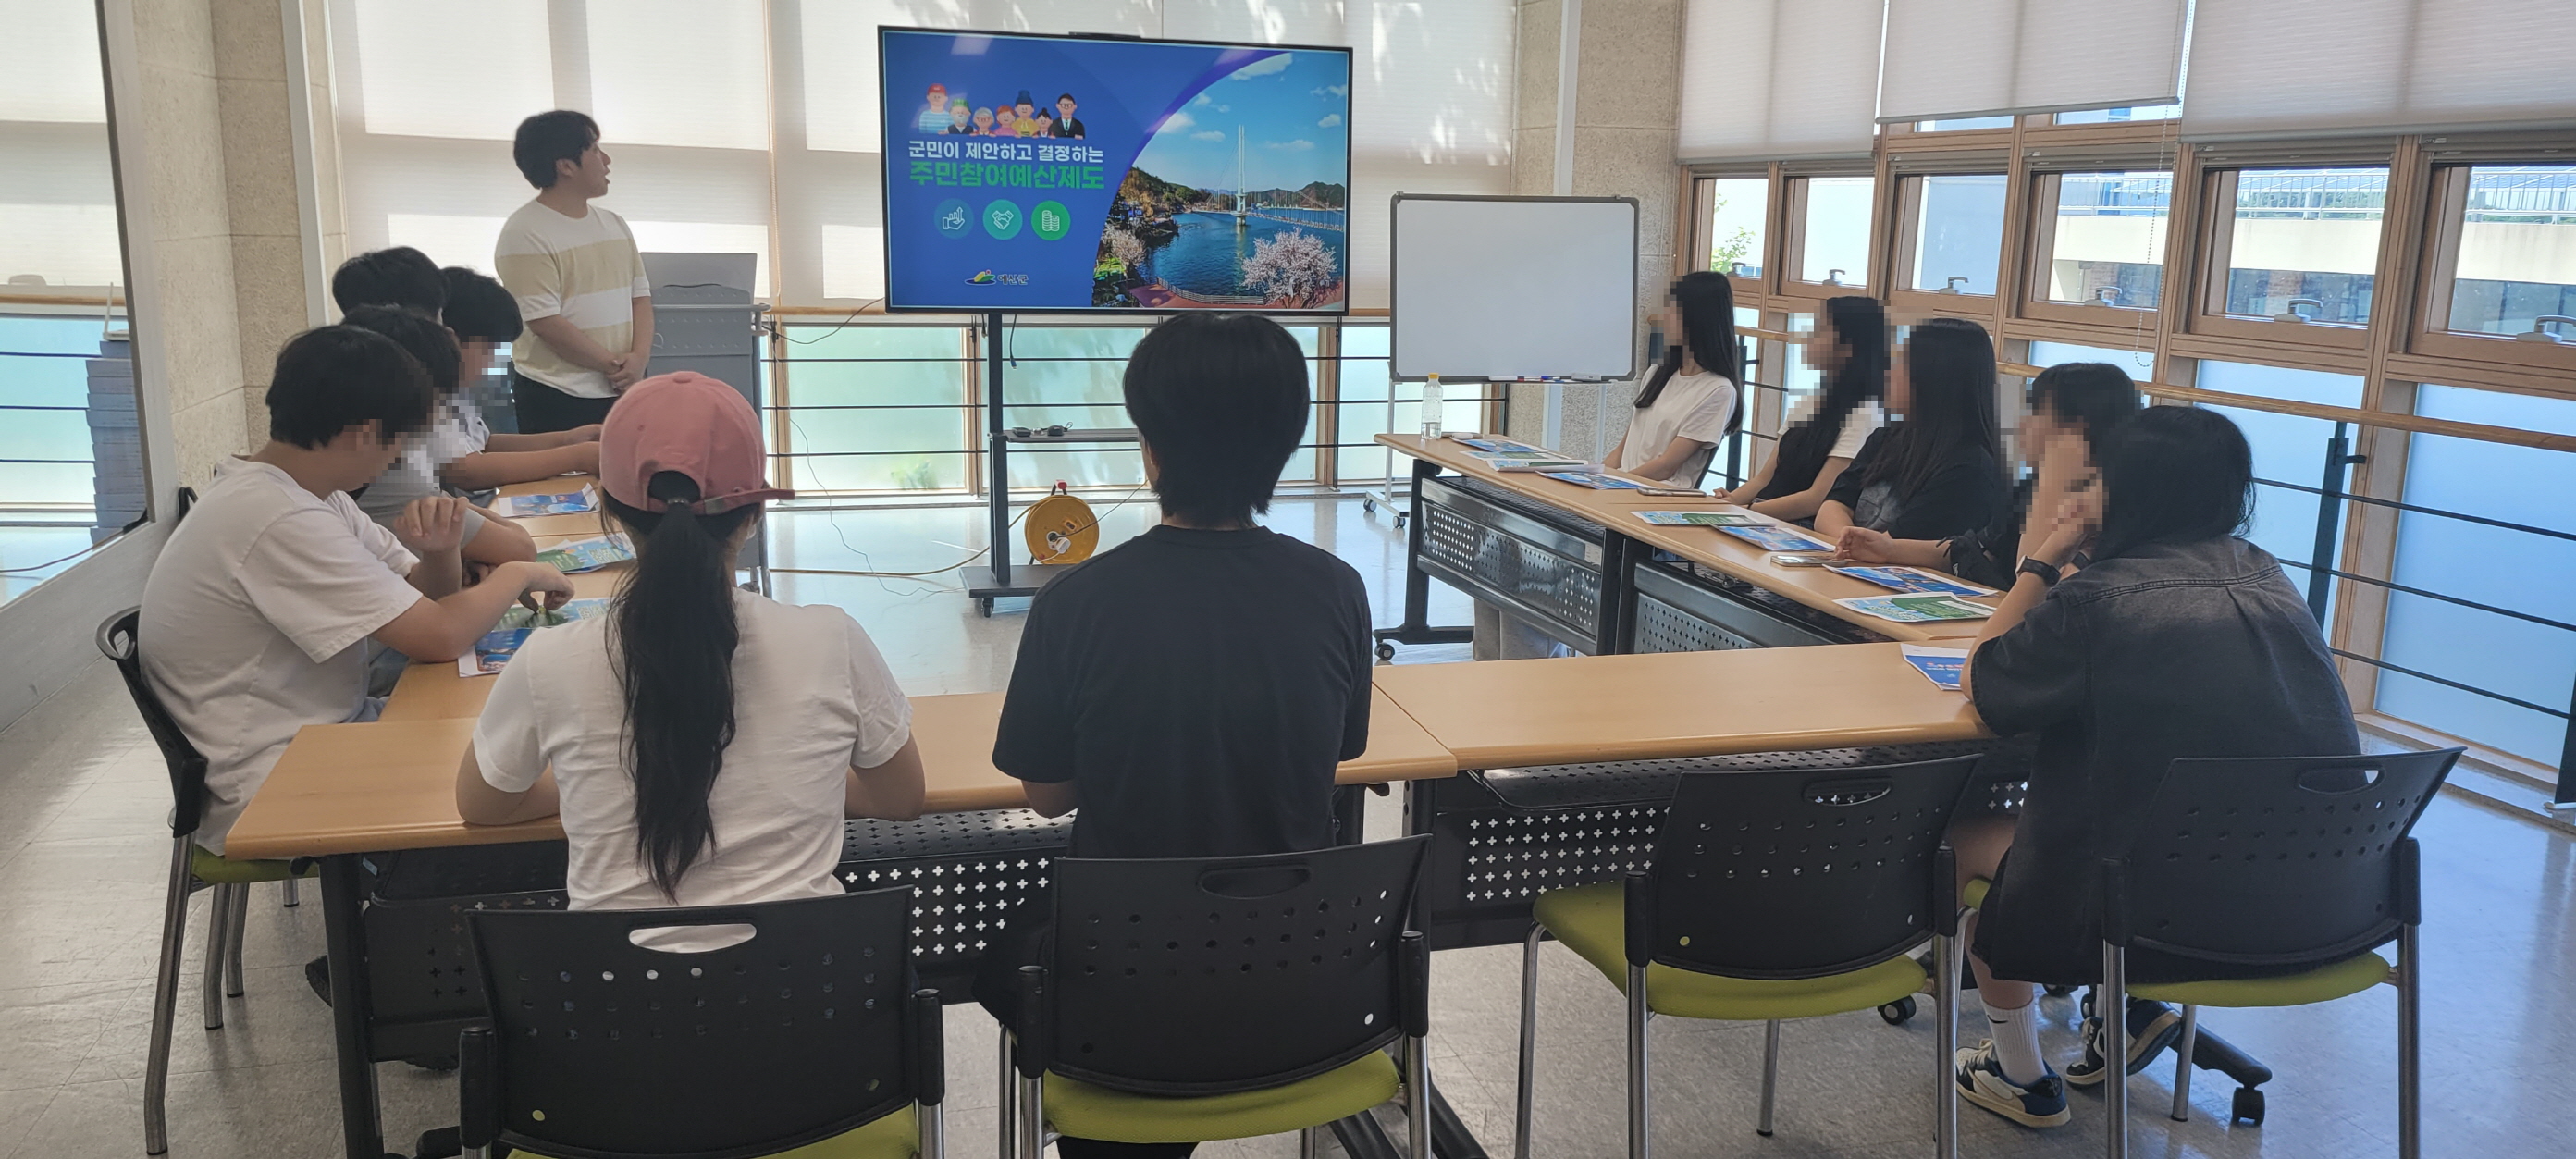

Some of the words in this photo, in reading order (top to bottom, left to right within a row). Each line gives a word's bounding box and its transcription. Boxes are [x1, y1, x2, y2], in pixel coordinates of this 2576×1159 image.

[908, 140, 959, 159] 군민이
[965, 142, 1032, 161] 제안하고
[1037, 144, 1103, 163] 결정하는
[909, 161, 1105, 189] 주민참여예산제도
[997, 274, 1029, 286] 예산군
